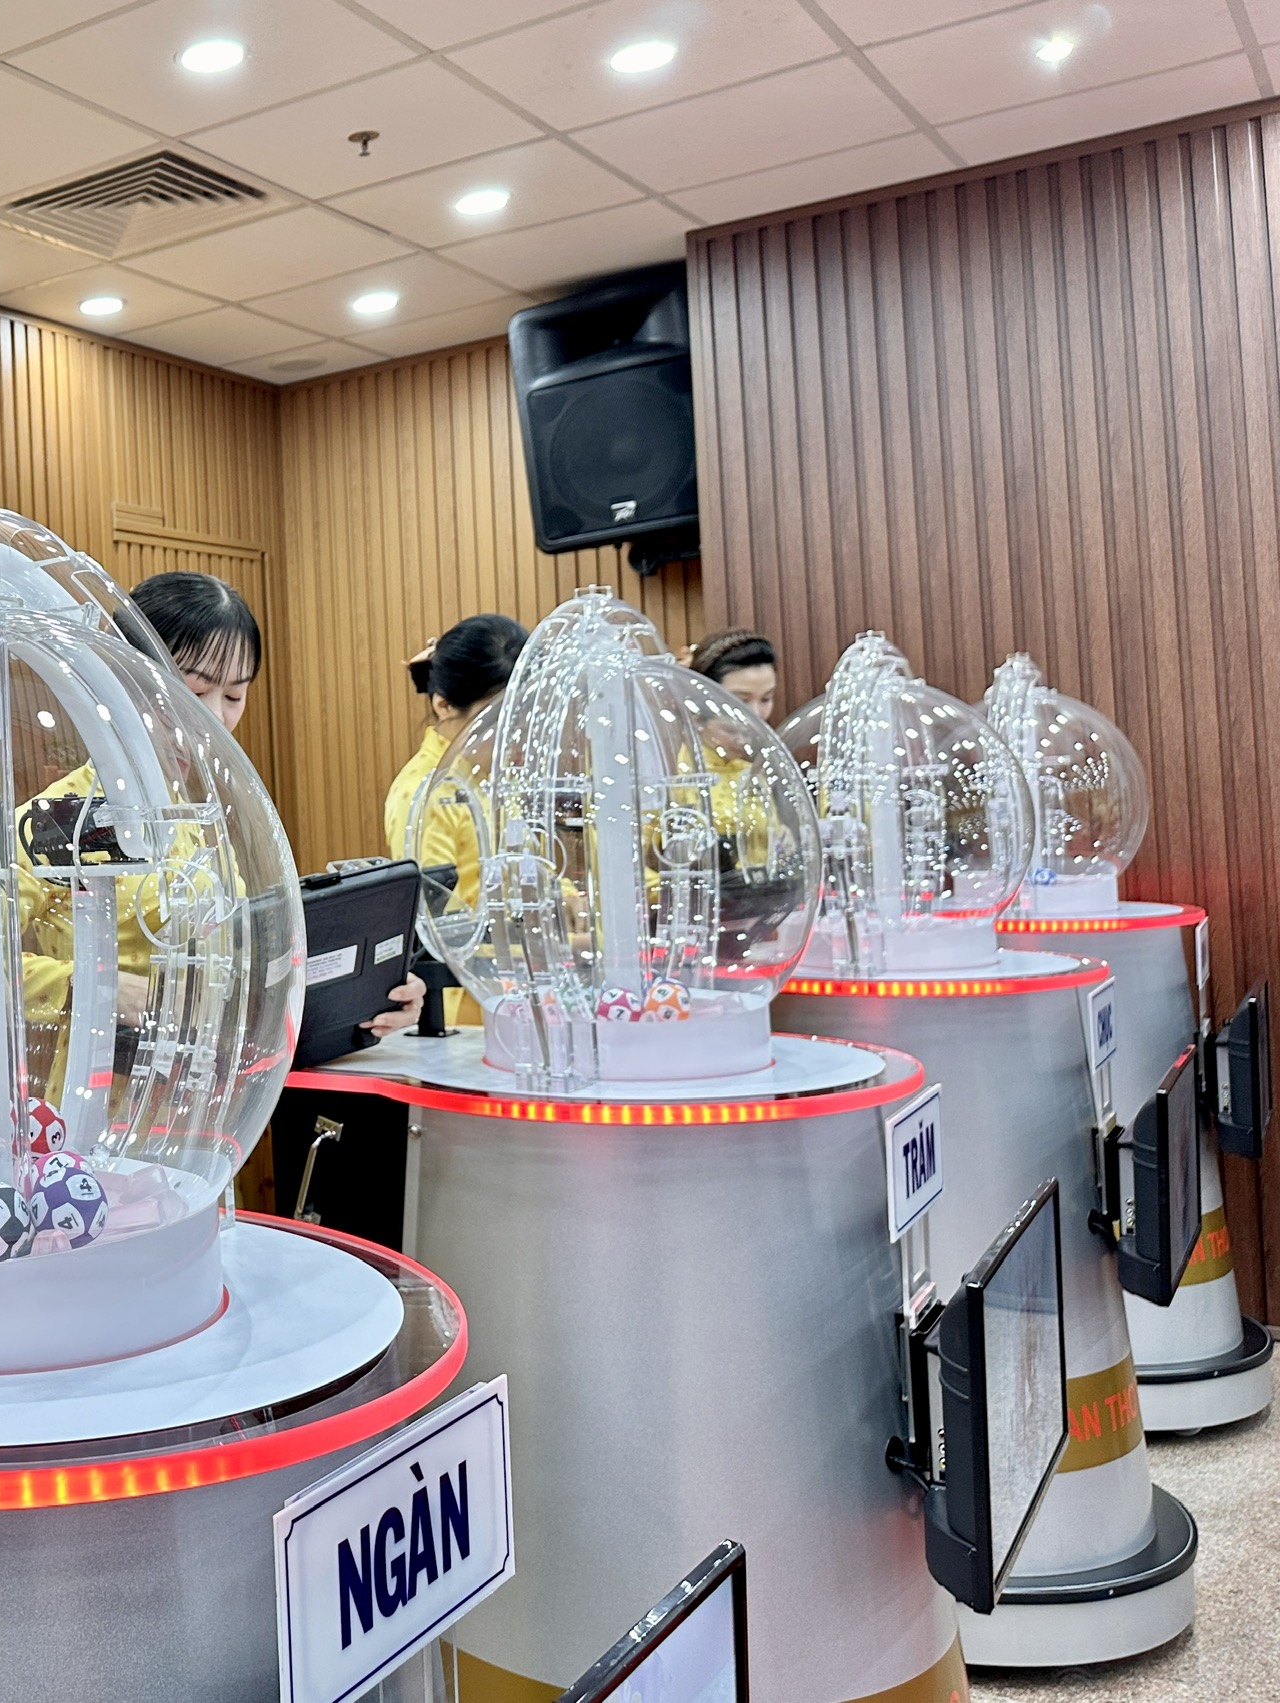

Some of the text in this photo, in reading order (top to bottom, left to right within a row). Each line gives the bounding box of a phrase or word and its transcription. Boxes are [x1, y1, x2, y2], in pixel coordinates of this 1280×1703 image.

[51, 1132, 61, 1144] 3
[80, 1178, 92, 1191] 4
[57, 1216, 73, 1229] 4
[337, 1459, 470, 1650] NGÀN
